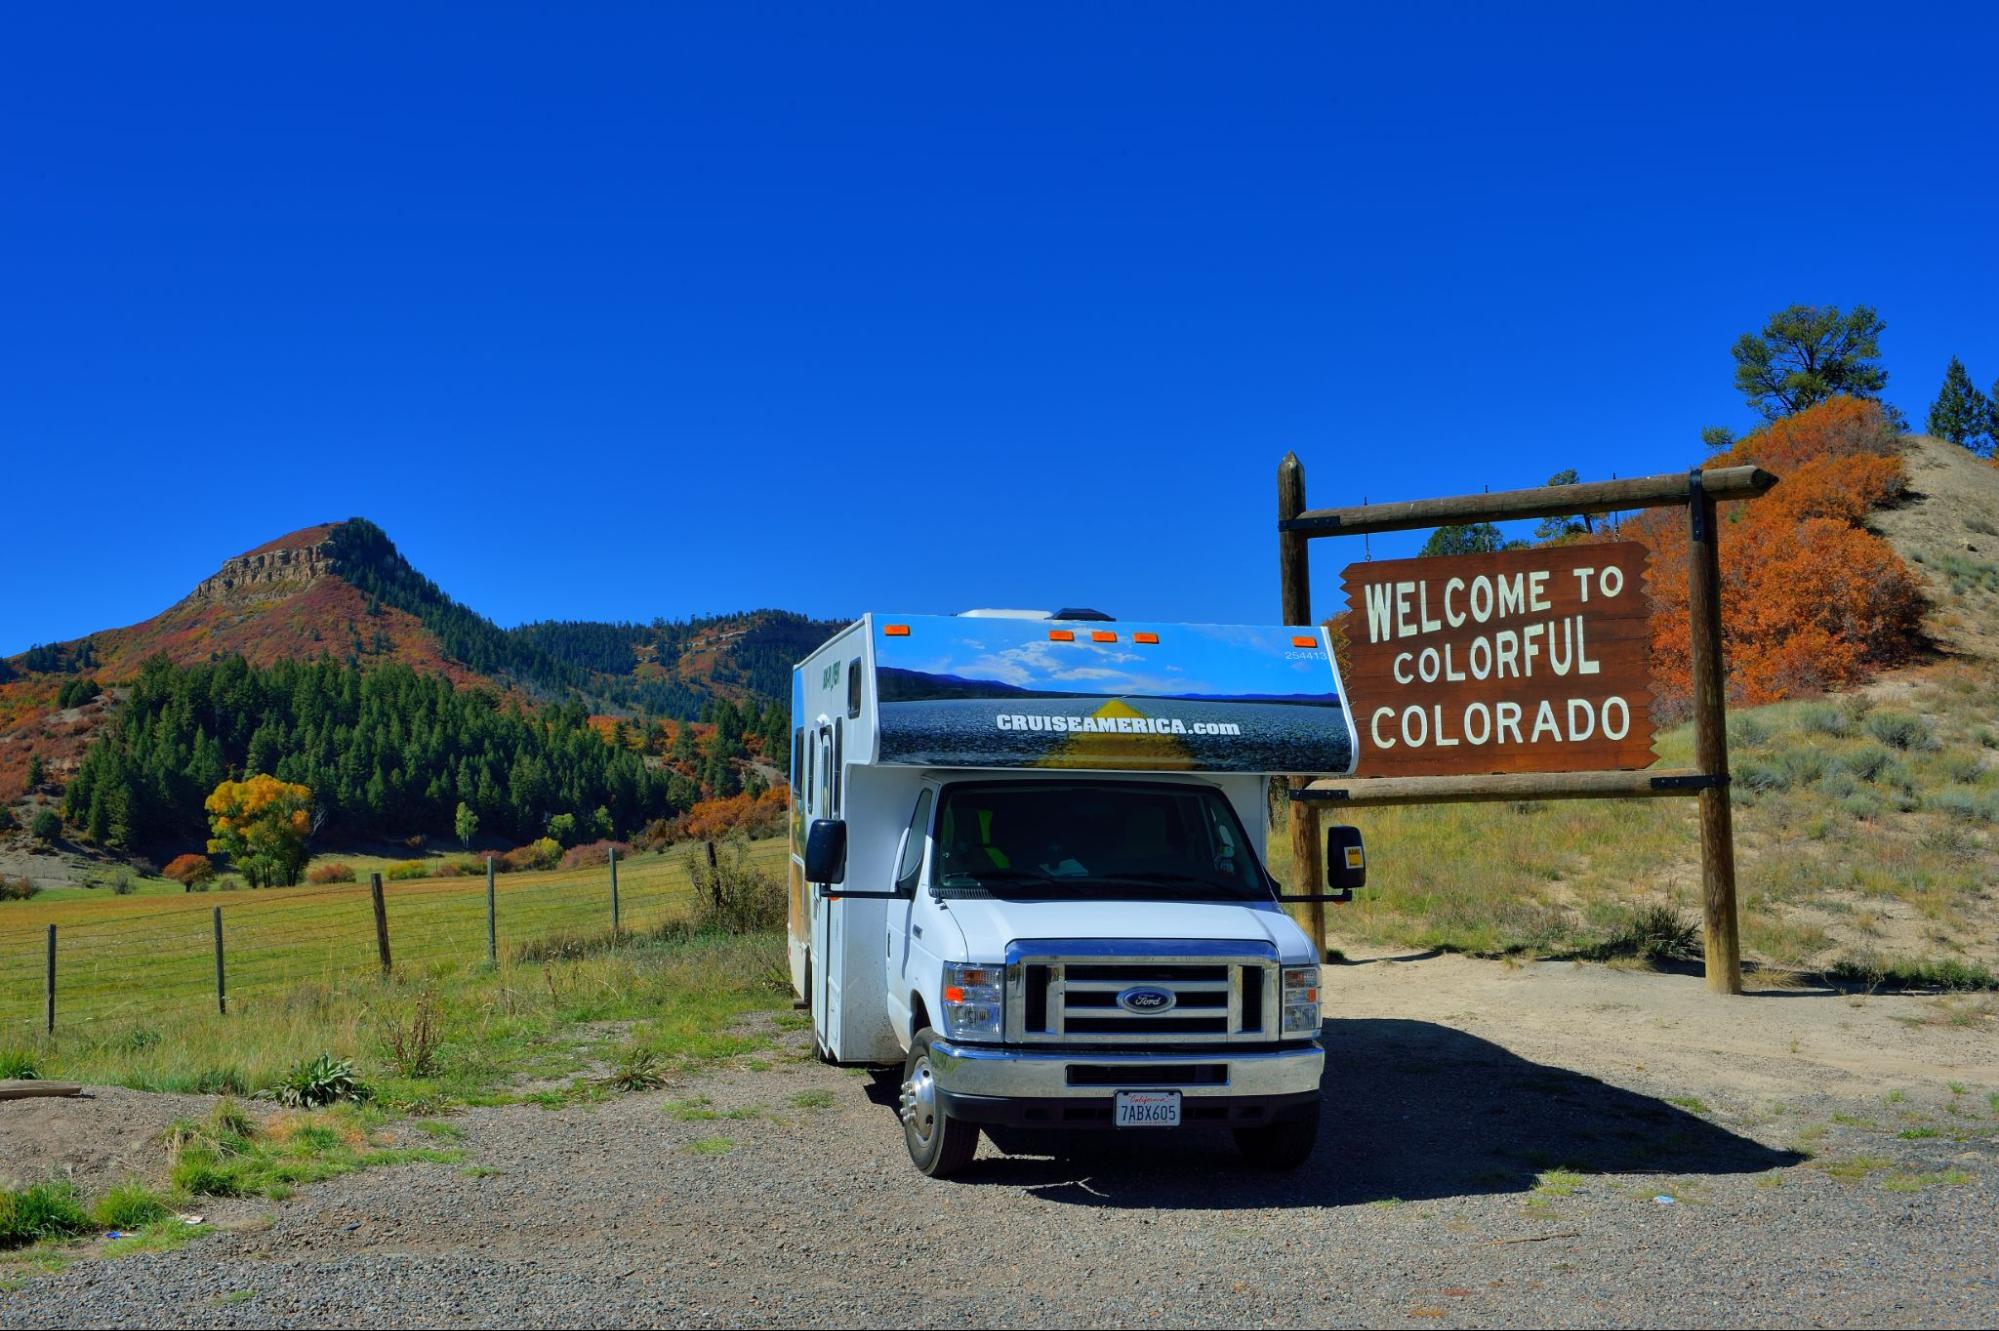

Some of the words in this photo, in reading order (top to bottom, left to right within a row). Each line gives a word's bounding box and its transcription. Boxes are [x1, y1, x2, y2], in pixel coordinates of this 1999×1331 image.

[1365, 571, 1551, 643] WELCOME
[1573, 565, 1624, 602] TO
[1284, 651, 1328, 661] 254413
[1393, 615, 1600, 684] COLORFUL
[996, 714, 1241, 736] CRUISEAMERICA.com
[1371, 696, 1630, 749] COLORADO
[1135, 993, 1161, 1006] Ford
[1121, 1105, 1176, 1121] 7ABX605
